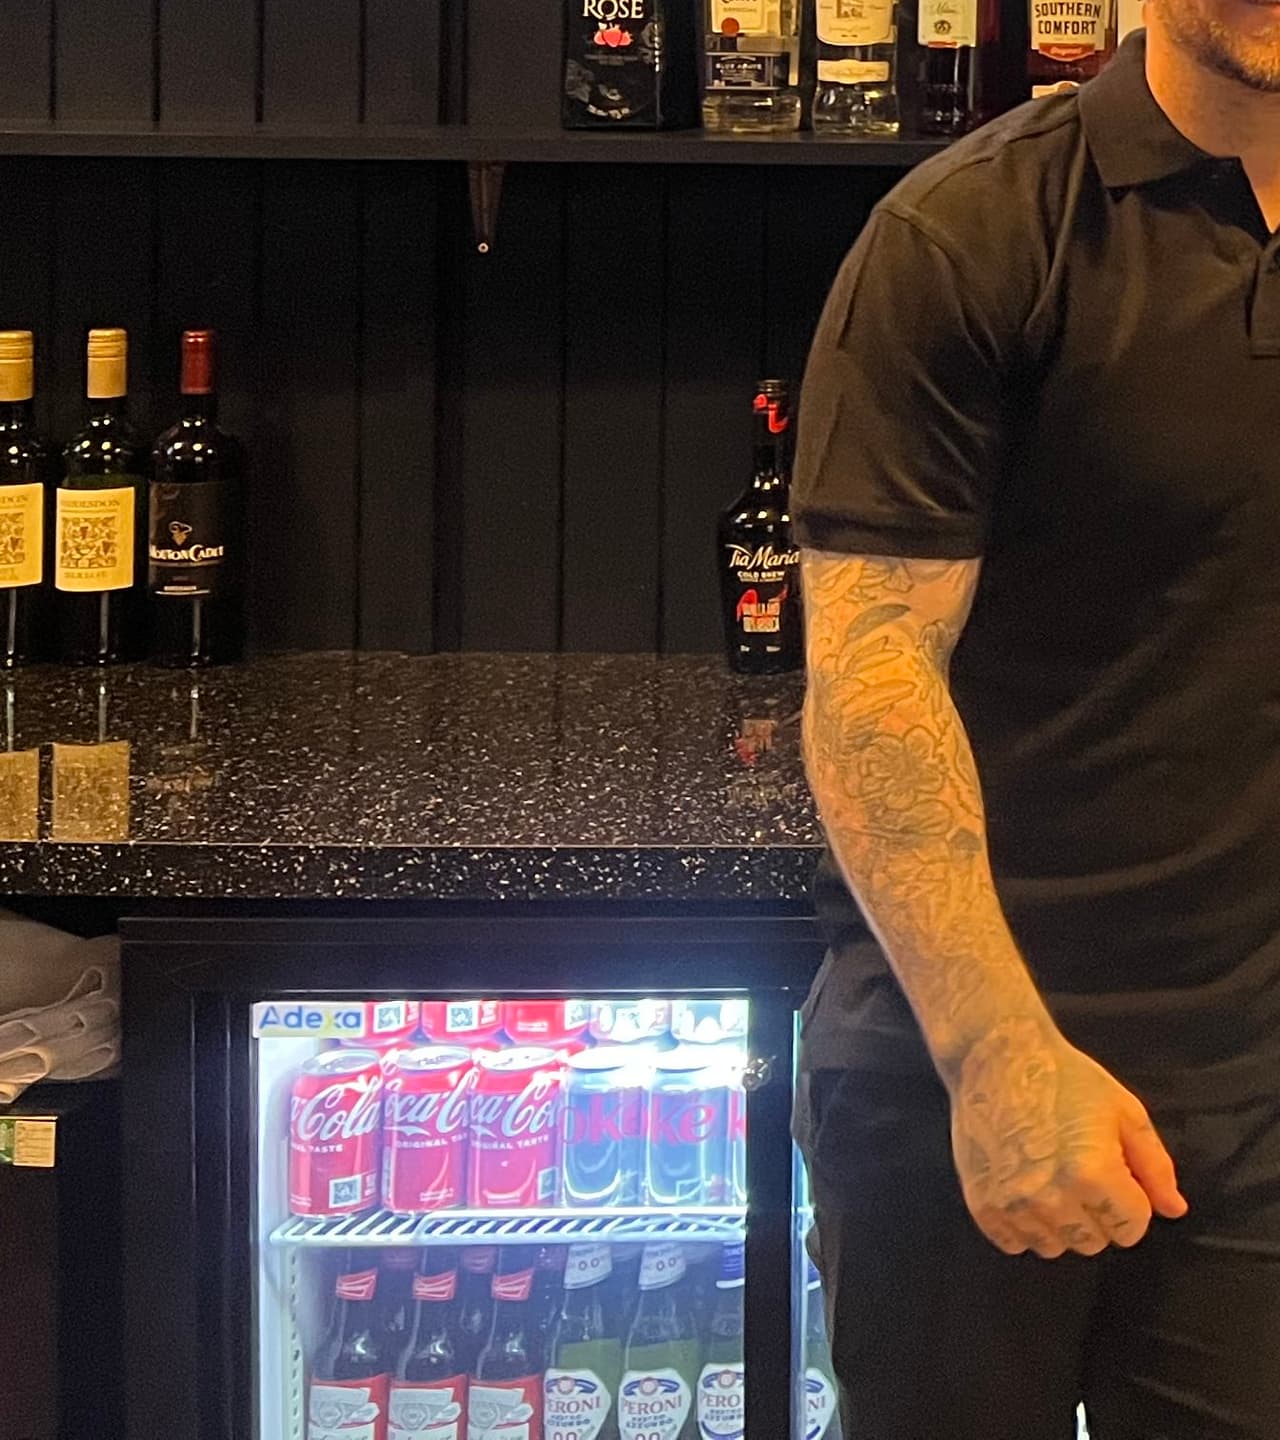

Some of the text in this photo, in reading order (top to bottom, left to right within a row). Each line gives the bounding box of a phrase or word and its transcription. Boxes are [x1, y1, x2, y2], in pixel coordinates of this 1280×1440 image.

[1034, 2, 1102, 19] SOUTHERN
[1037, 20, 1098, 36] COMFORT
[746, 545, 800, 570] Maria
[701, 1391, 741, 1409] PERO
